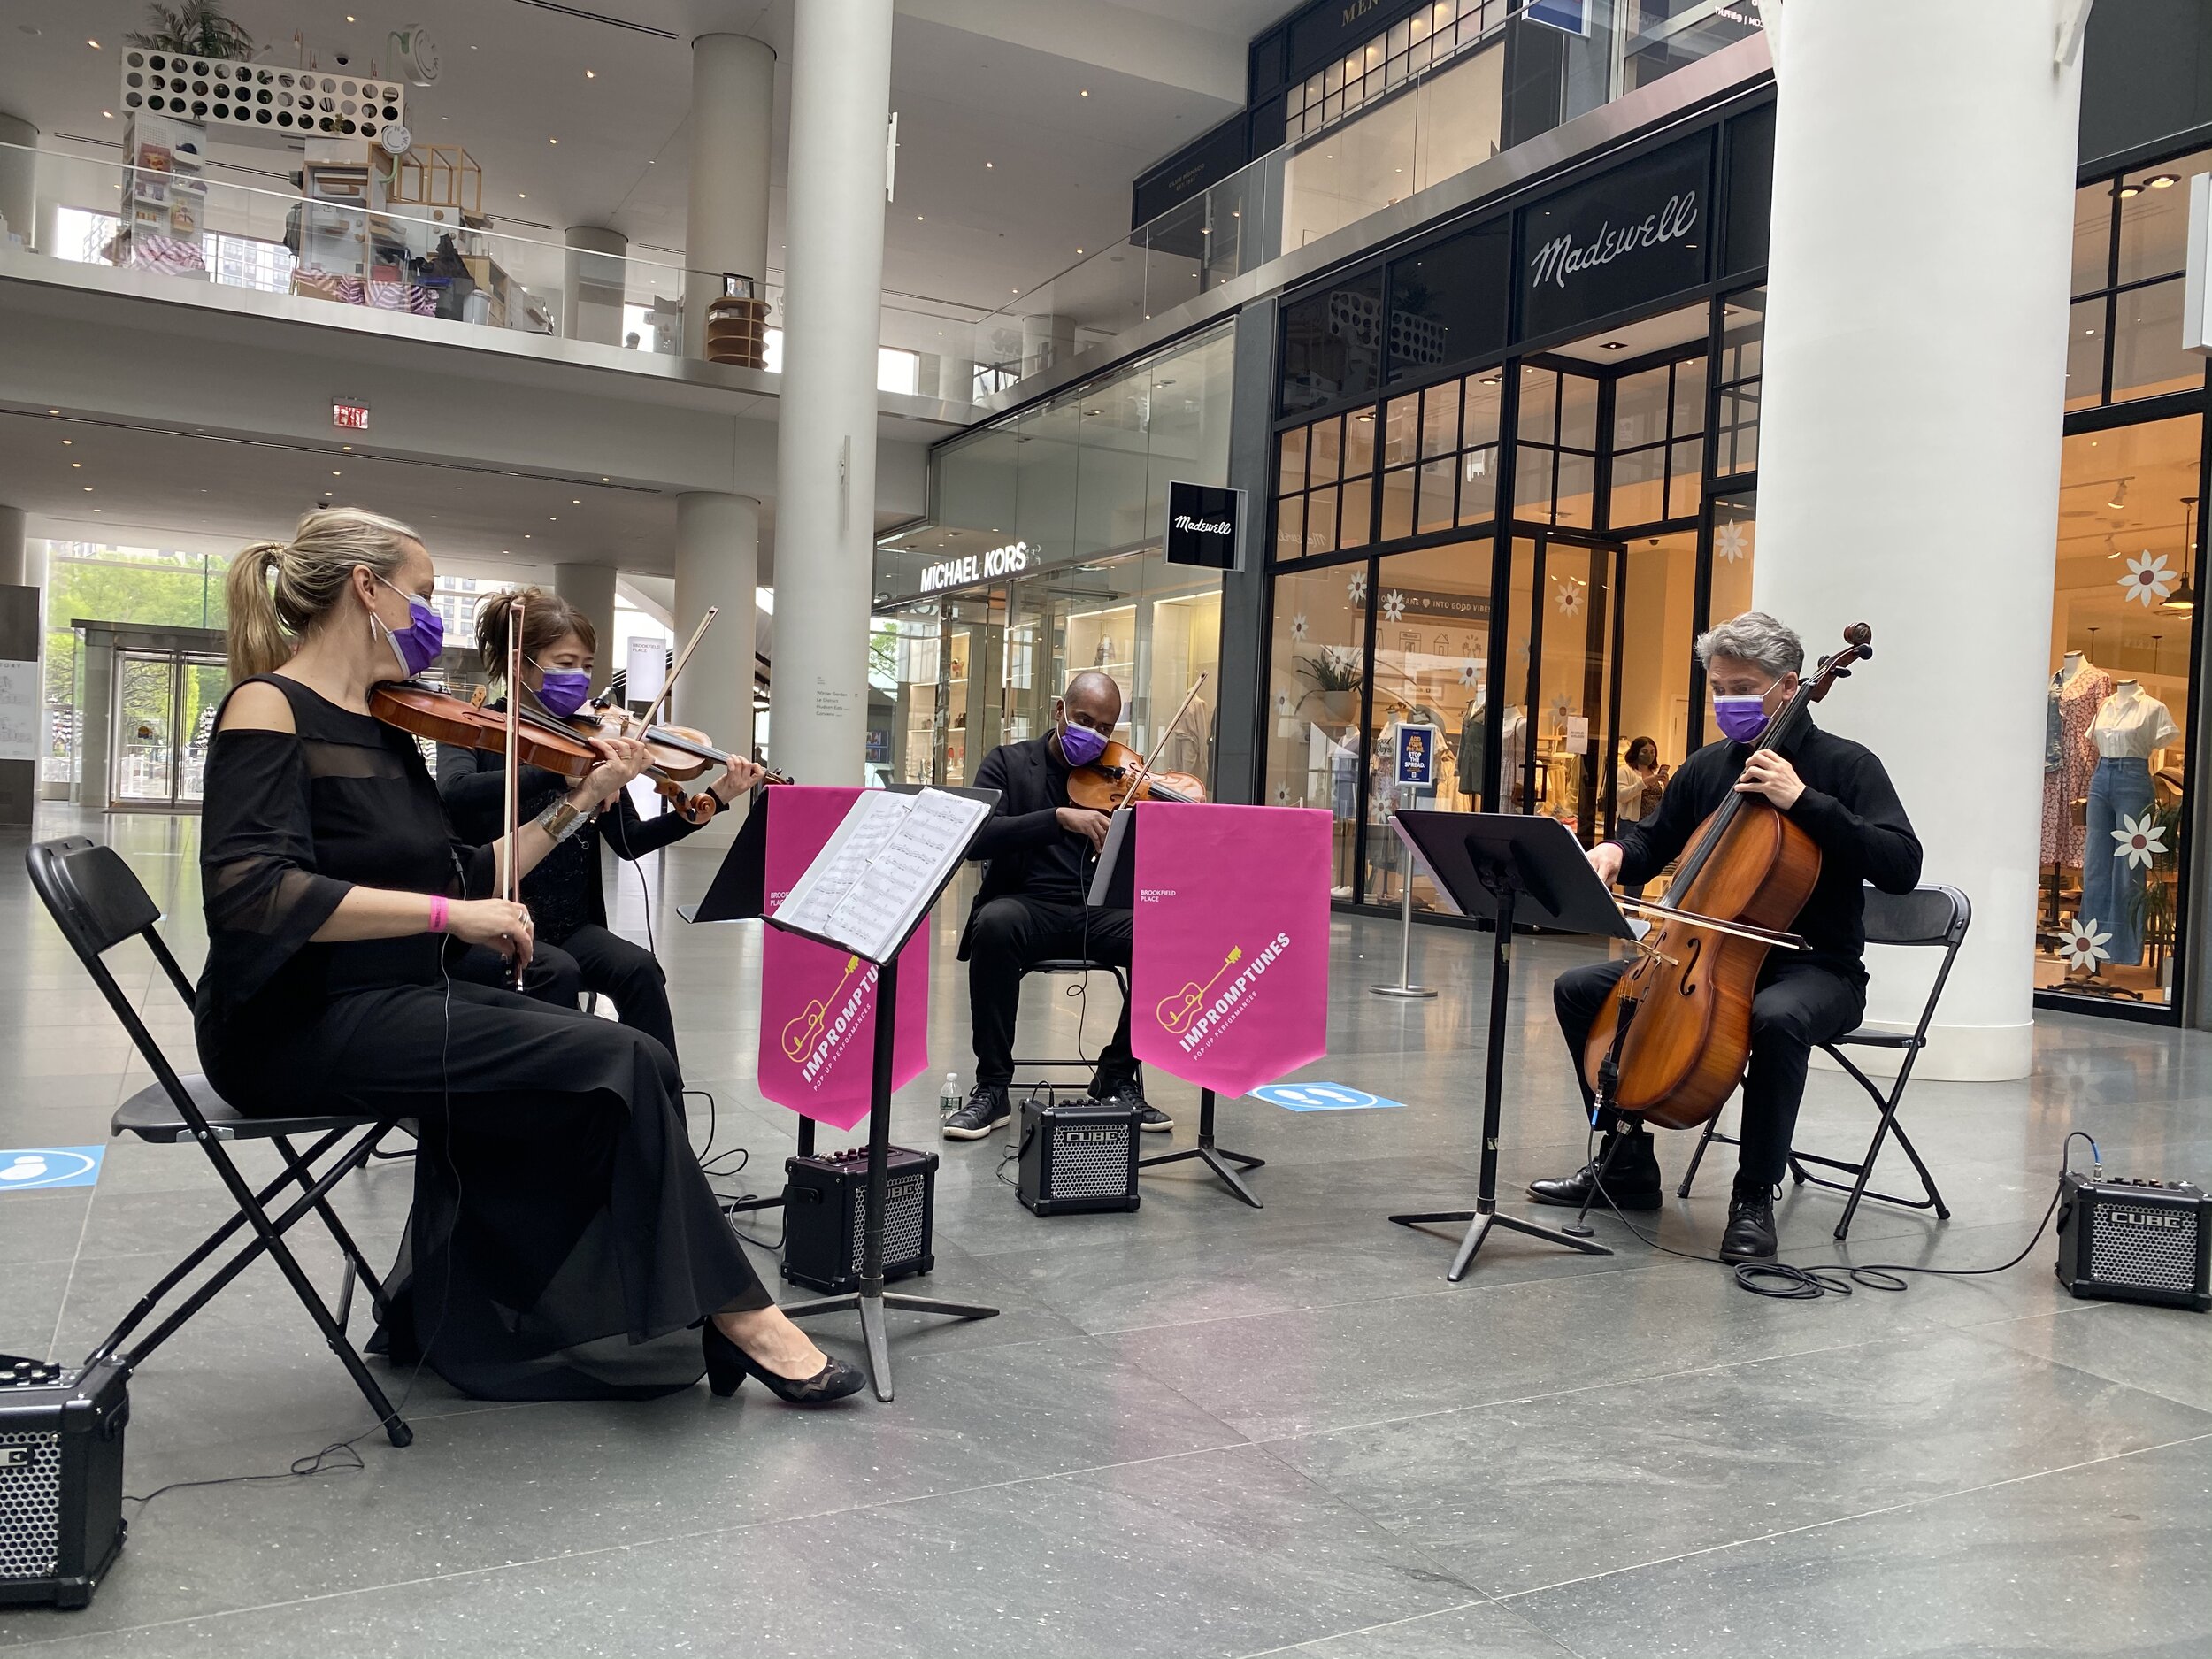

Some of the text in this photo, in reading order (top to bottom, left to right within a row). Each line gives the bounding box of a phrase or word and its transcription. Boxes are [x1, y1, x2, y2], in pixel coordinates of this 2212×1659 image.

[1530, 190, 1698, 288] Madewell
[338, 405, 365, 426] EXIT
[1174, 515, 1232, 535] Madewell
[920, 541, 1027, 593] MICHAEL KORS
[1401, 597, 1420, 606] EANS
[1451, 603, 1471, 611] GOOD
[1179, 932, 1291, 1054] IMPROMPTUNES
[801, 964, 879, 1084] IMPROMPTU
[1193, 990, 1258, 1061] POP-UP PERFORMANCES
[813, 1002, 872, 1092] POP-UP PERFORMANCES
[1066, 1131, 1119, 1143] CUBE
[885, 1183, 916, 1200] BE
[2111, 1211, 2182, 1229] CUBE
